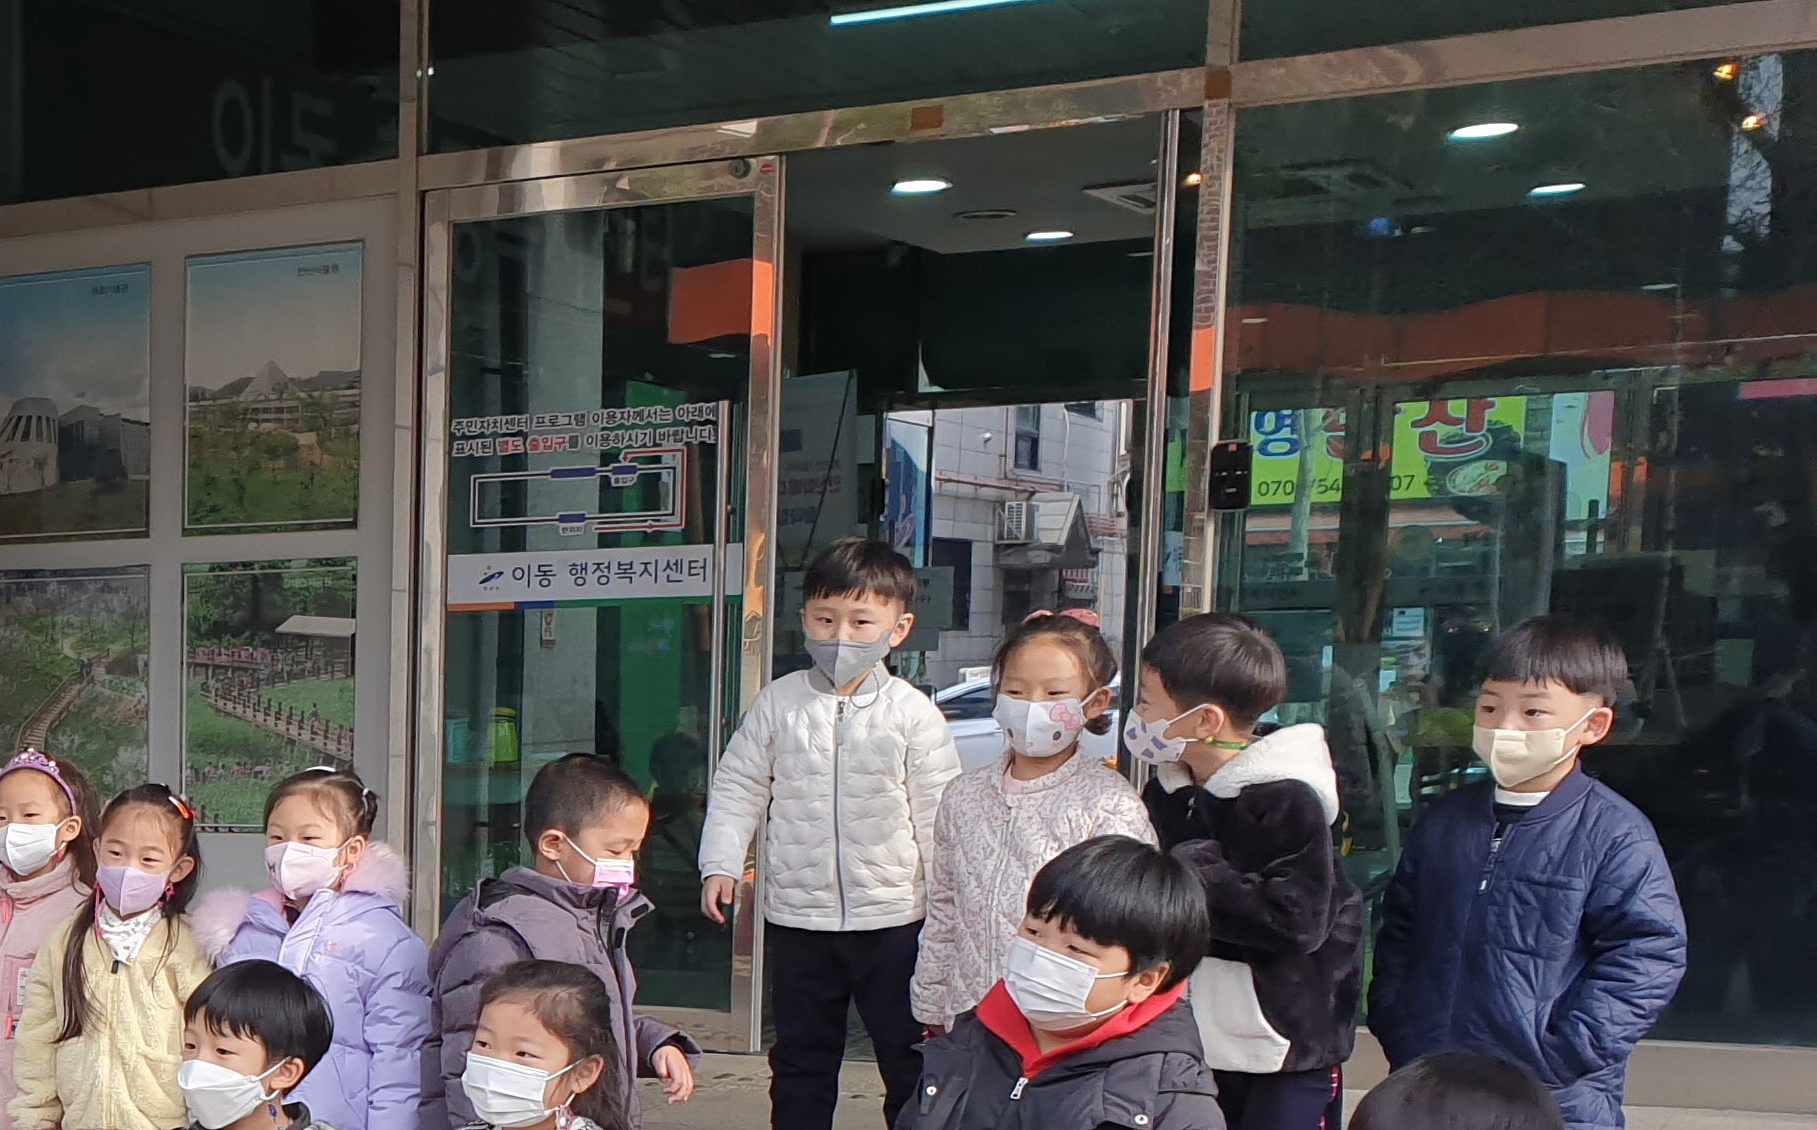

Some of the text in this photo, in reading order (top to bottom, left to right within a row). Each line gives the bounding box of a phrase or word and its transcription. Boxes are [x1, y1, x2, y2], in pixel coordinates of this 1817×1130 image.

[452, 403, 716, 435] 주민자치센터 프로그램 이용자께서는 아래에
[454, 440, 493, 456] 표시된
[498, 439, 523, 454] 별도
[586, 429, 653, 448] 이용하시기
[1257, 480, 1295, 497] 070
[512, 558, 707, 588] 이동 행정복지센터
